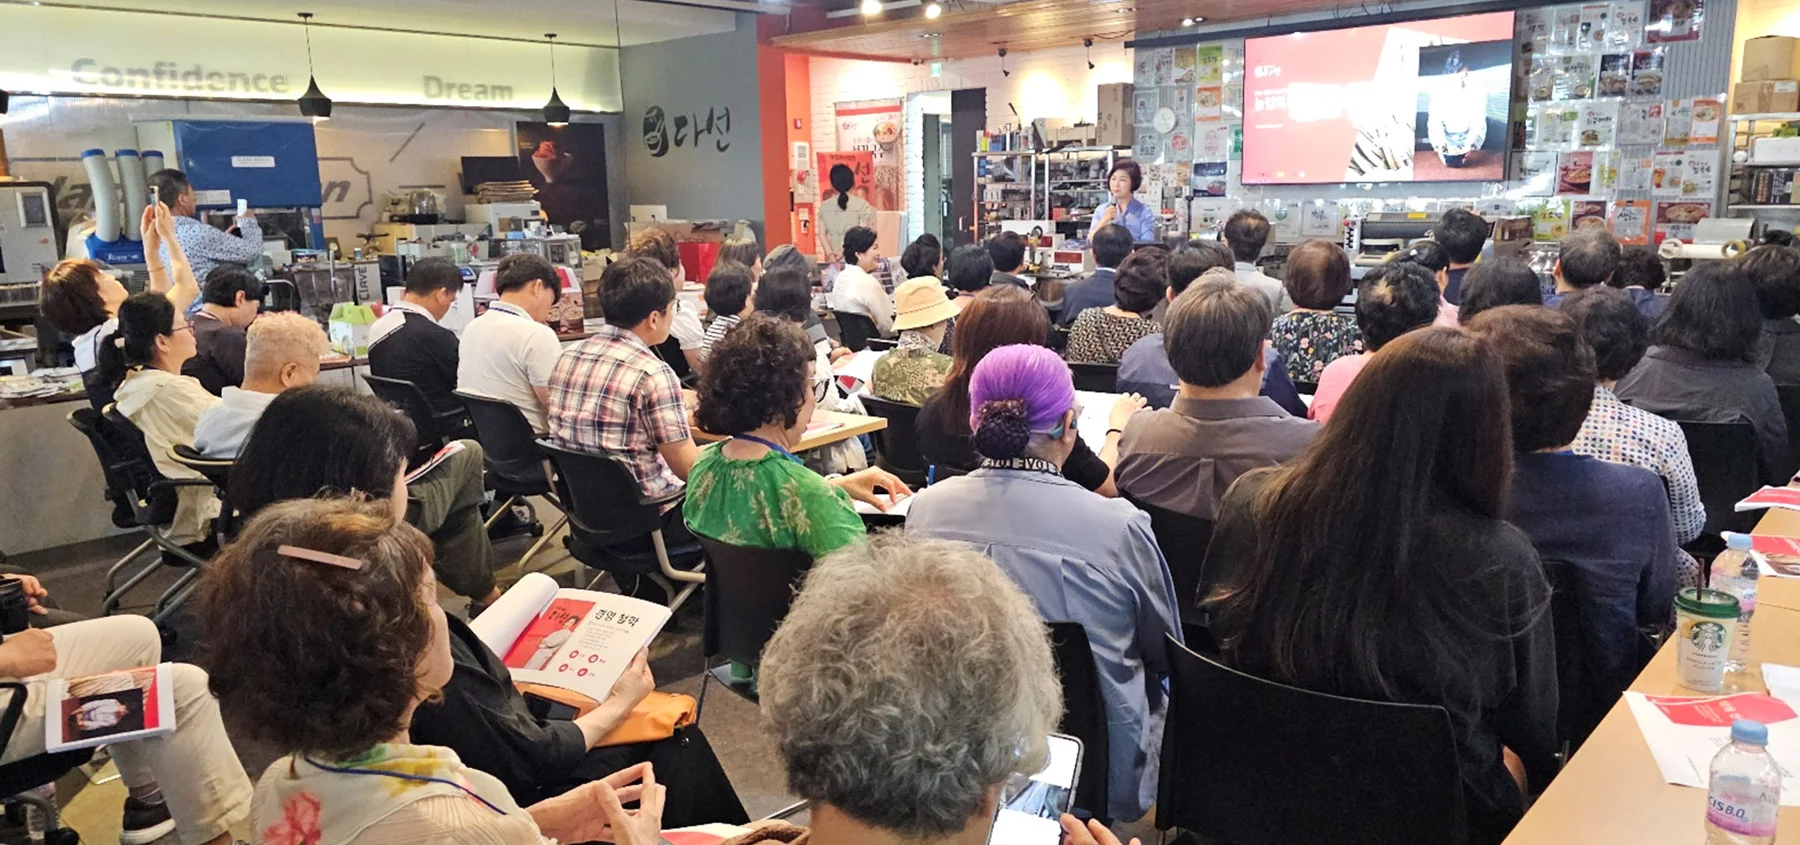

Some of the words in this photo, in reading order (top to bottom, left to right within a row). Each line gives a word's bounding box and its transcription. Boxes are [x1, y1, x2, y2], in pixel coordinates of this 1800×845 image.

[71, 57, 289, 93] Confidence
[422, 74, 514, 101] Dream
[673, 106, 731, 153] 다선
[594, 608, 617, 622] 경영
[616, 613, 640, 628] 철학
